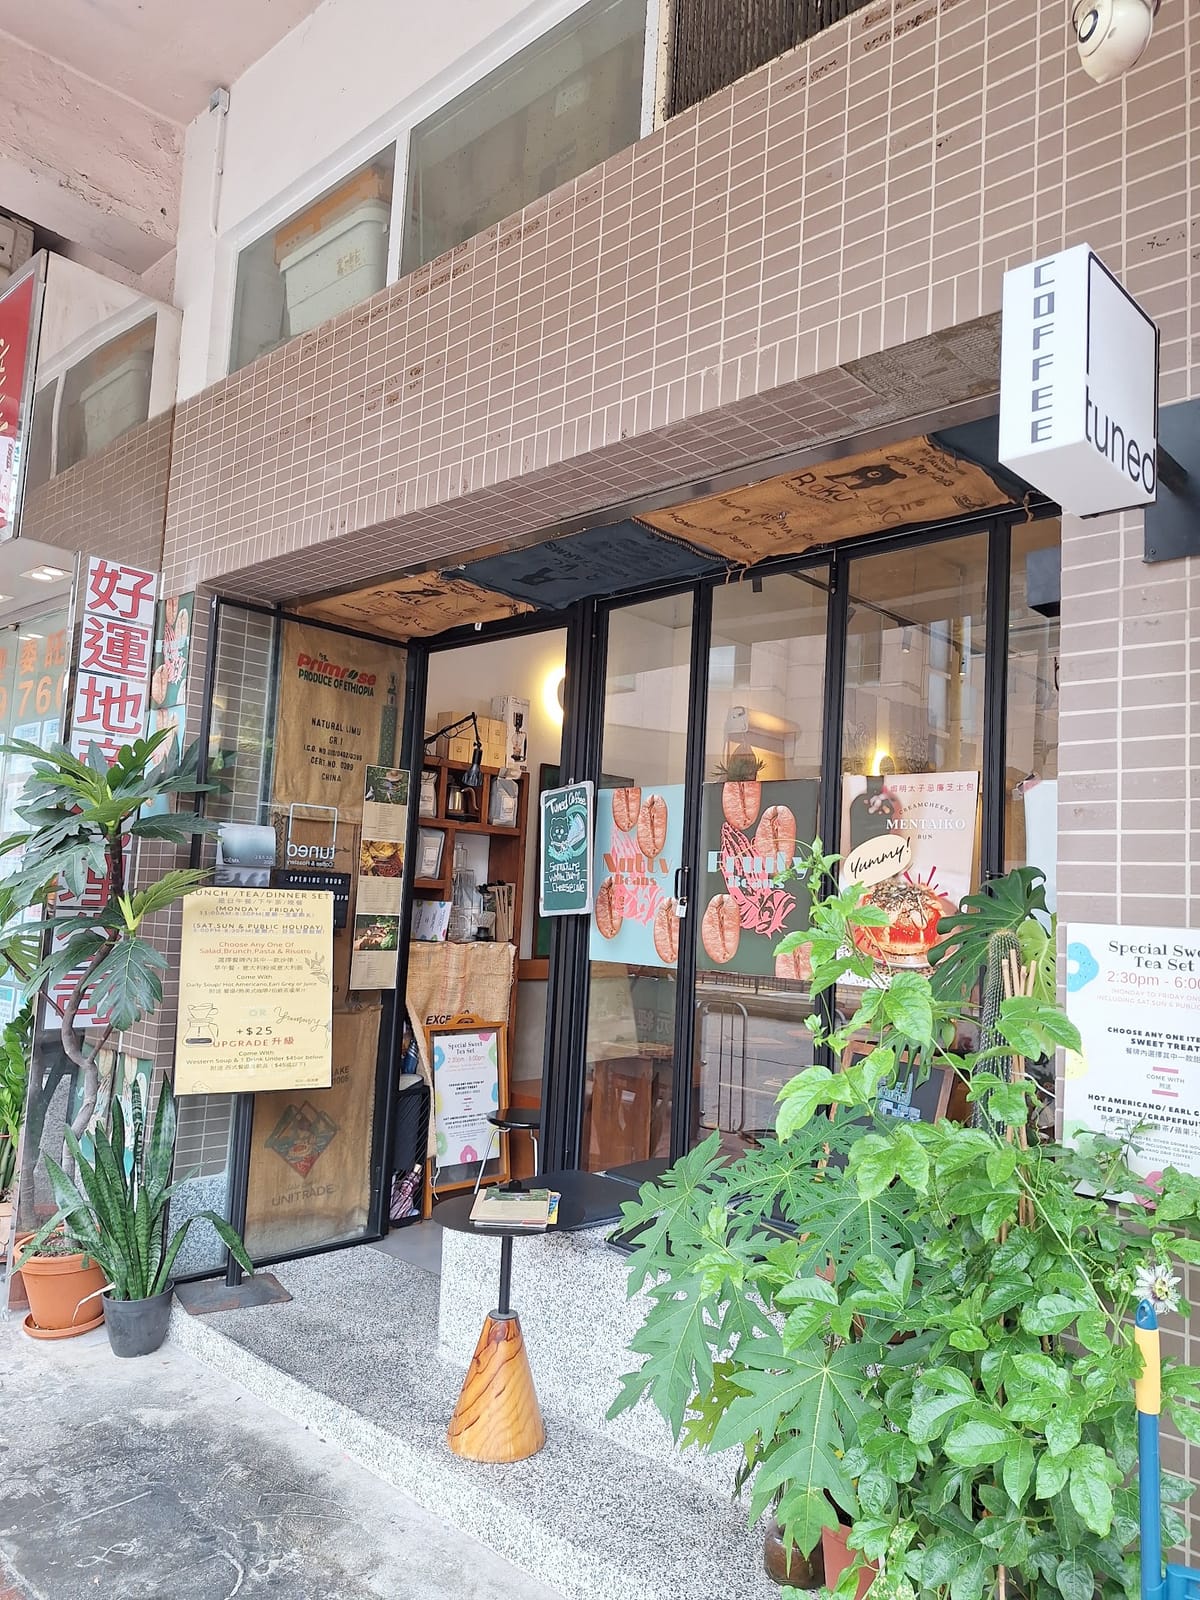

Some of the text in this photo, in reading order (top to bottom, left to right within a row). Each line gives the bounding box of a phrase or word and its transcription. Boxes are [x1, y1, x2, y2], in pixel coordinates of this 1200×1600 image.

[1031, 260, 1055, 444] COFFEE
[1085, 384, 1157, 494] tuned
[298, 668, 374, 697] PRODUCE OF ETHIOPIA
[311, 717, 361, 736] NATURAL LIMU
[321, 772, 342, 782] CHINA
[899, 802, 954, 815] CREAMCHEESE
[886, 818, 966, 830] MENTAIKO
[850, 837, 911, 879] Yummy!
[615, 874, 658, 886] Beans
[311, 892, 330, 900] SET
[1108, 940, 1167, 956] Special
[1134, 956, 1195, 972] Tea Set
[1107, 971, 1159, 988] 2:30pm
[1096, 995, 1138, 1004] INCLUDING
[1158, 992, 1185, 1000] FRIDAY
[249, 1008, 266, 1017] OR
[1107, 1026, 1142, 1037] CHOOSE
[1145, 1031, 1163, 1039] ANY
[1165, 1033, 1184, 1041] ONE
[212, 1037, 294, 1048] UPGRADE 升級
[1131, 1038, 1200, 1052] SWEET TREAT
[1146, 1073, 1185, 1084] COME WITH
[1088, 1093, 1106, 1102] HOT
[1108, 1096, 1166, 1112] AMERICANO/
[1168, 1106, 1191, 1116] EARL
[1093, 1104, 1113, 1113] ICED
[271, 1183, 336, 1207] UNITRADE
